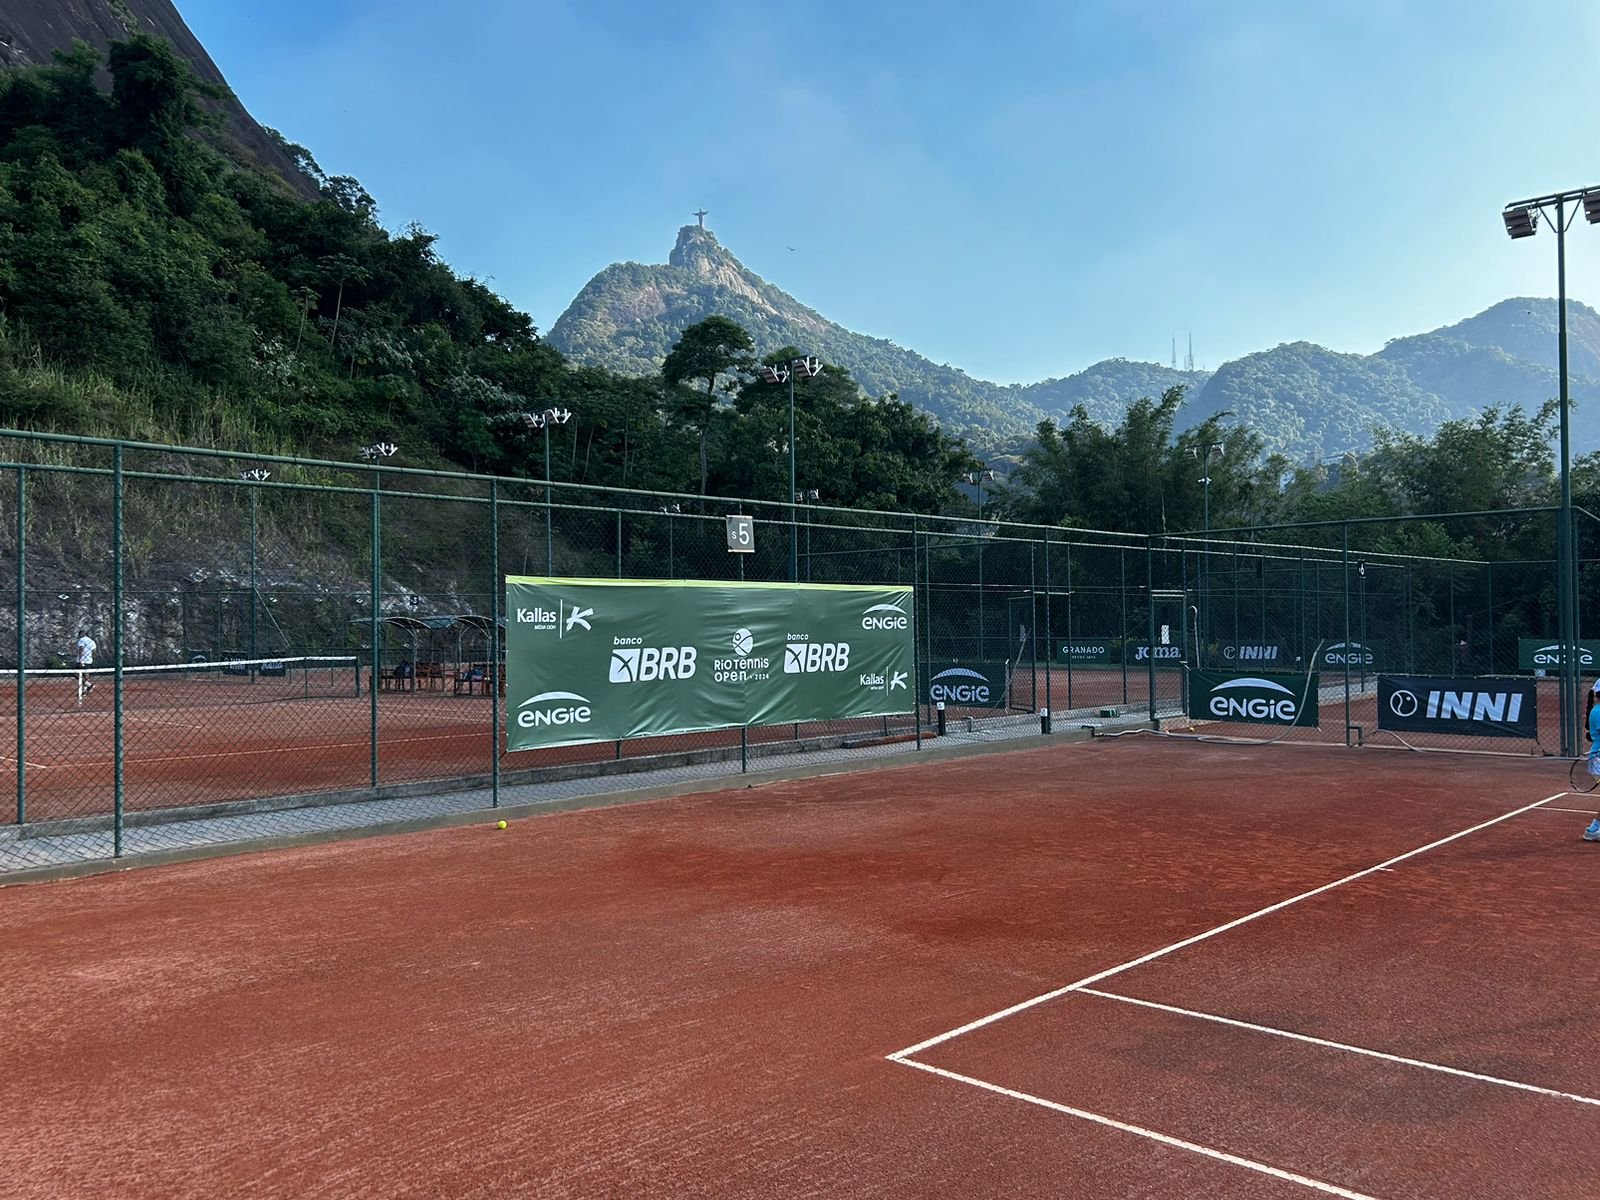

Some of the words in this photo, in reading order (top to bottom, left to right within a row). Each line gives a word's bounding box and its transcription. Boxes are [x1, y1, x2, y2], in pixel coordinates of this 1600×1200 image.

[738, 522, 750, 545] 5
[517, 607, 557, 623] Kallas
[613, 636, 643, 645] banco
[786, 632, 809, 641] banco
[806, 642, 850, 673] BRB
[1062, 646, 1105, 654] GRANADO
[1239, 646, 1278, 660] INNI
[639, 646, 697, 682] BRB
[860, 673, 885, 686] Kallas
[1425, 690, 1523, 722] INNI
